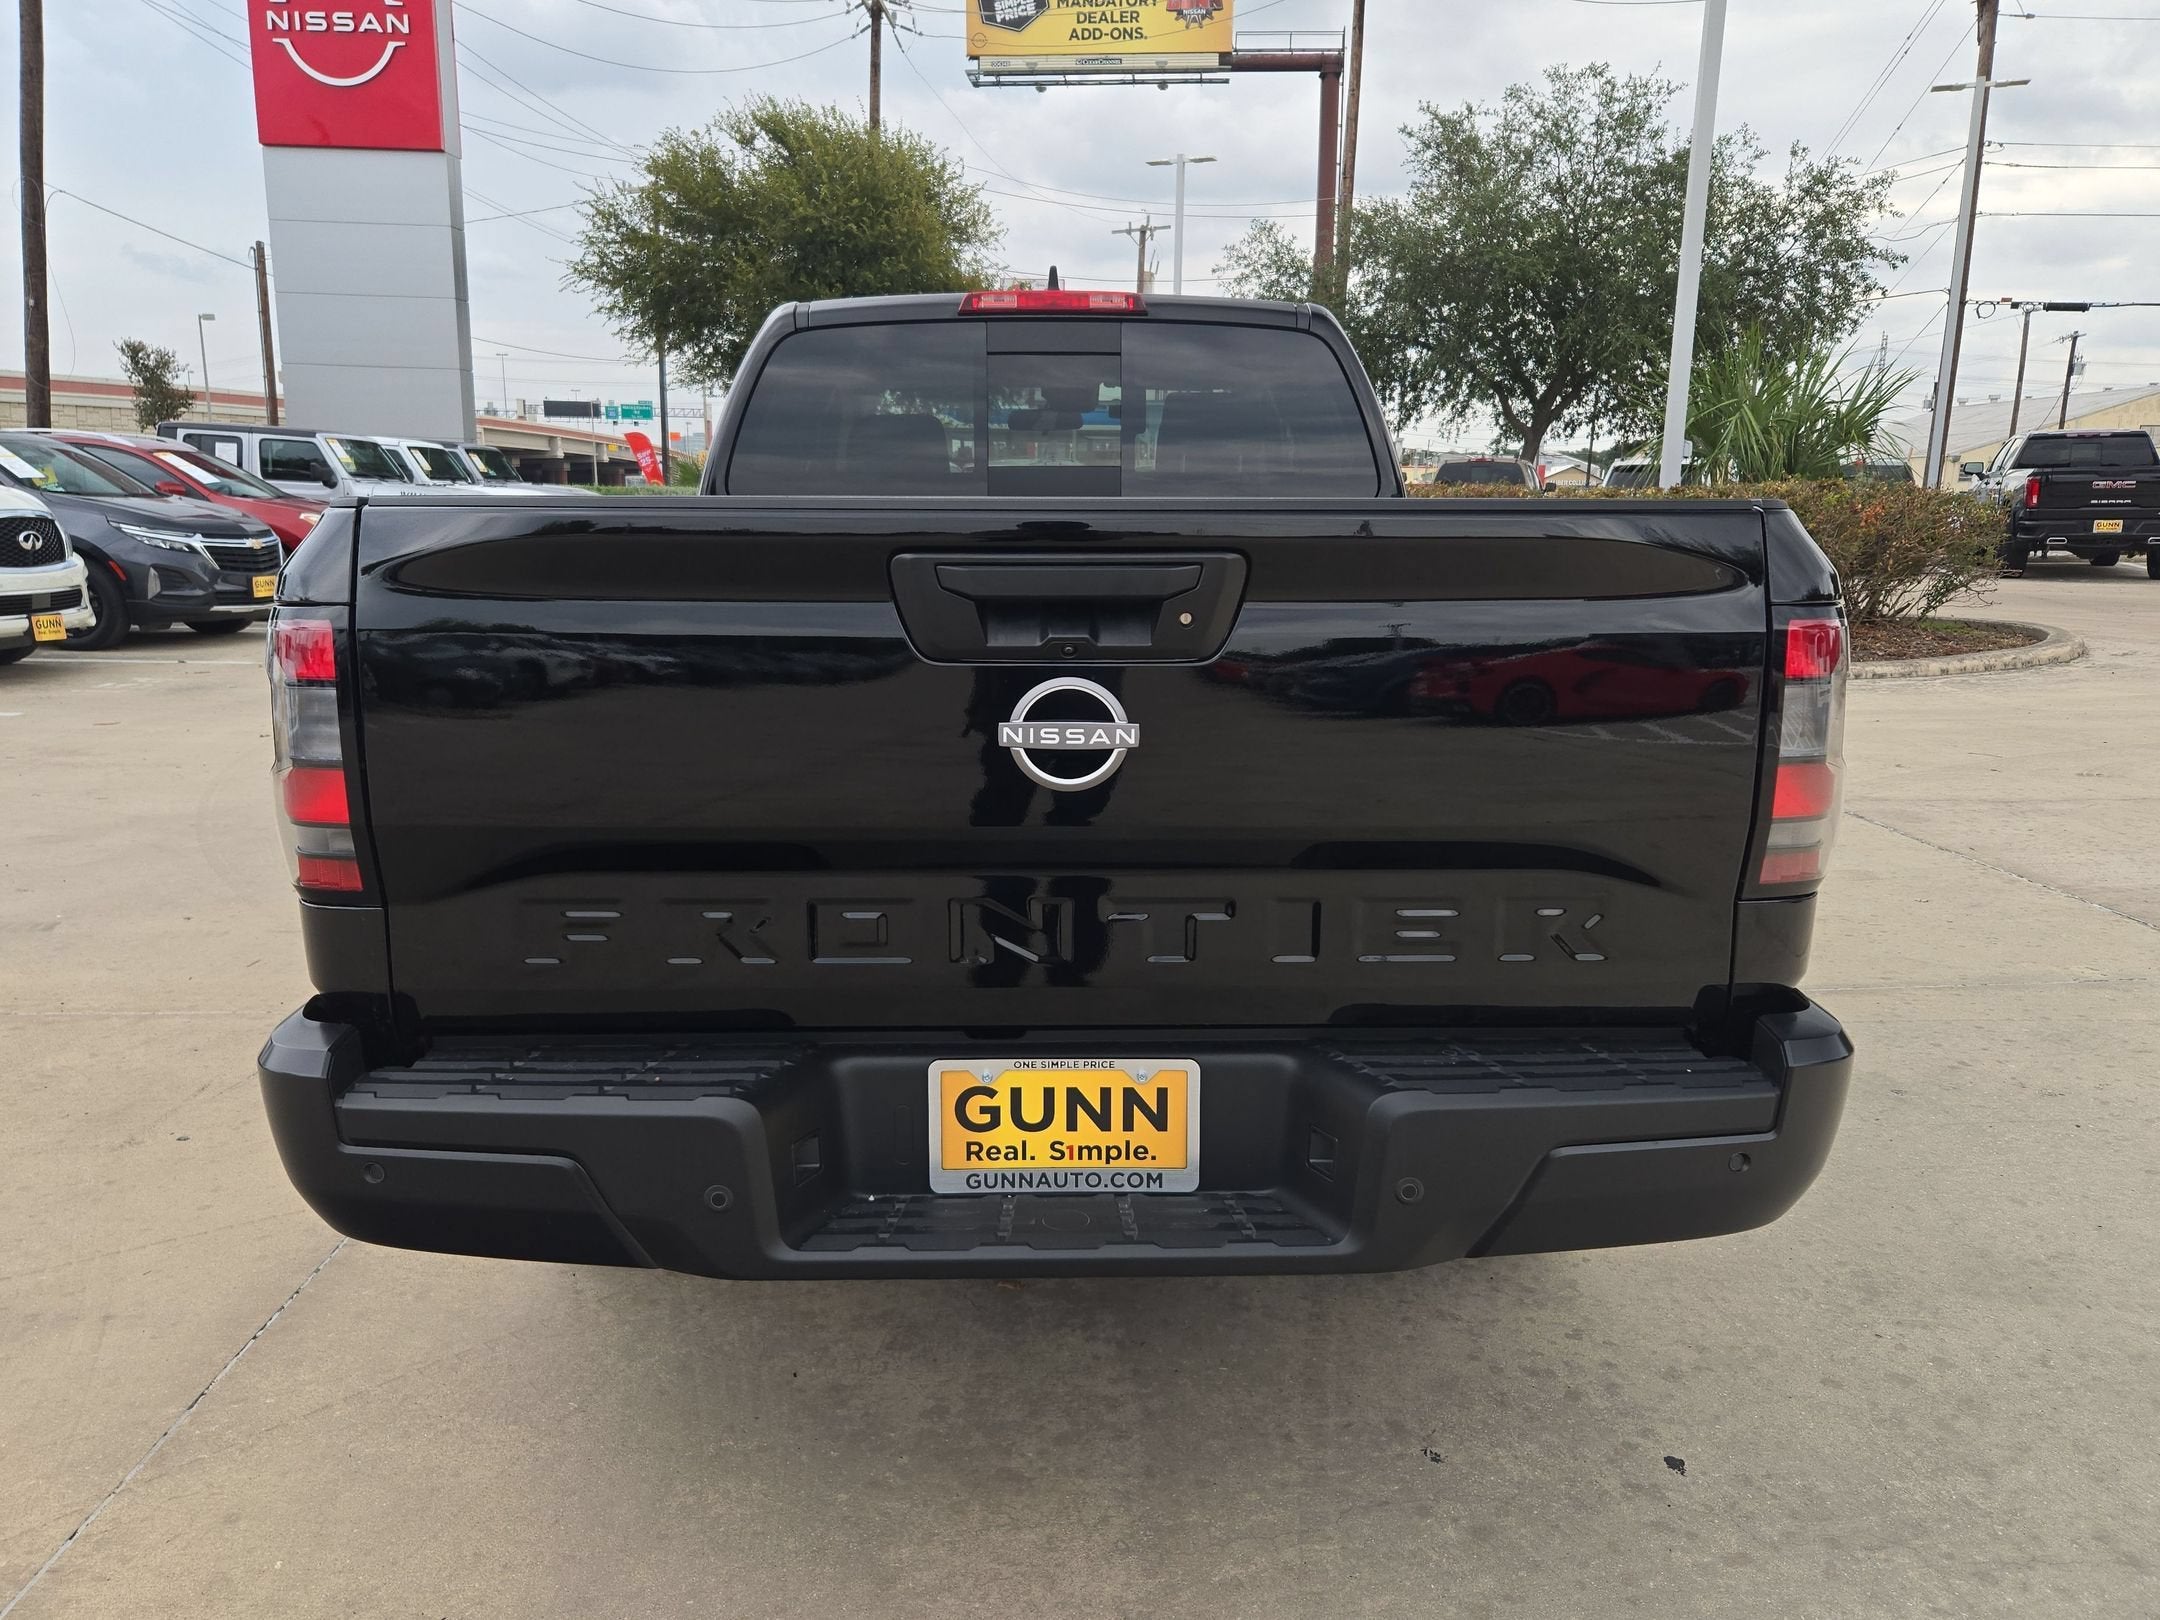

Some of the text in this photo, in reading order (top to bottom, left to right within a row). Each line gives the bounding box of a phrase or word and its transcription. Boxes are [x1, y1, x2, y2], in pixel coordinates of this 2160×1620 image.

[994, 0, 1034, 10] SIMP
[996, 2, 1037, 23] PRICE
[266, 10, 410, 34] NISSAN
[1076, 11, 1140, 24] DEALER
[1069, 27, 1148, 40] ADD-ONS.
[254, 580, 275, 589] GUNN
[35, 617, 62, 629] GUNN
[1002, 727, 1136, 745] NISSAN
[522, 898, 1606, 965] FRONTIER
[1013, 1060, 1116, 1069] ONE SIMPLE PRICE
[954, 1085, 1169, 1133] GUNN
[965, 1140, 1036, 1162] Real.
[965, 1172, 1164, 1189] GUNNAUTO.COM
